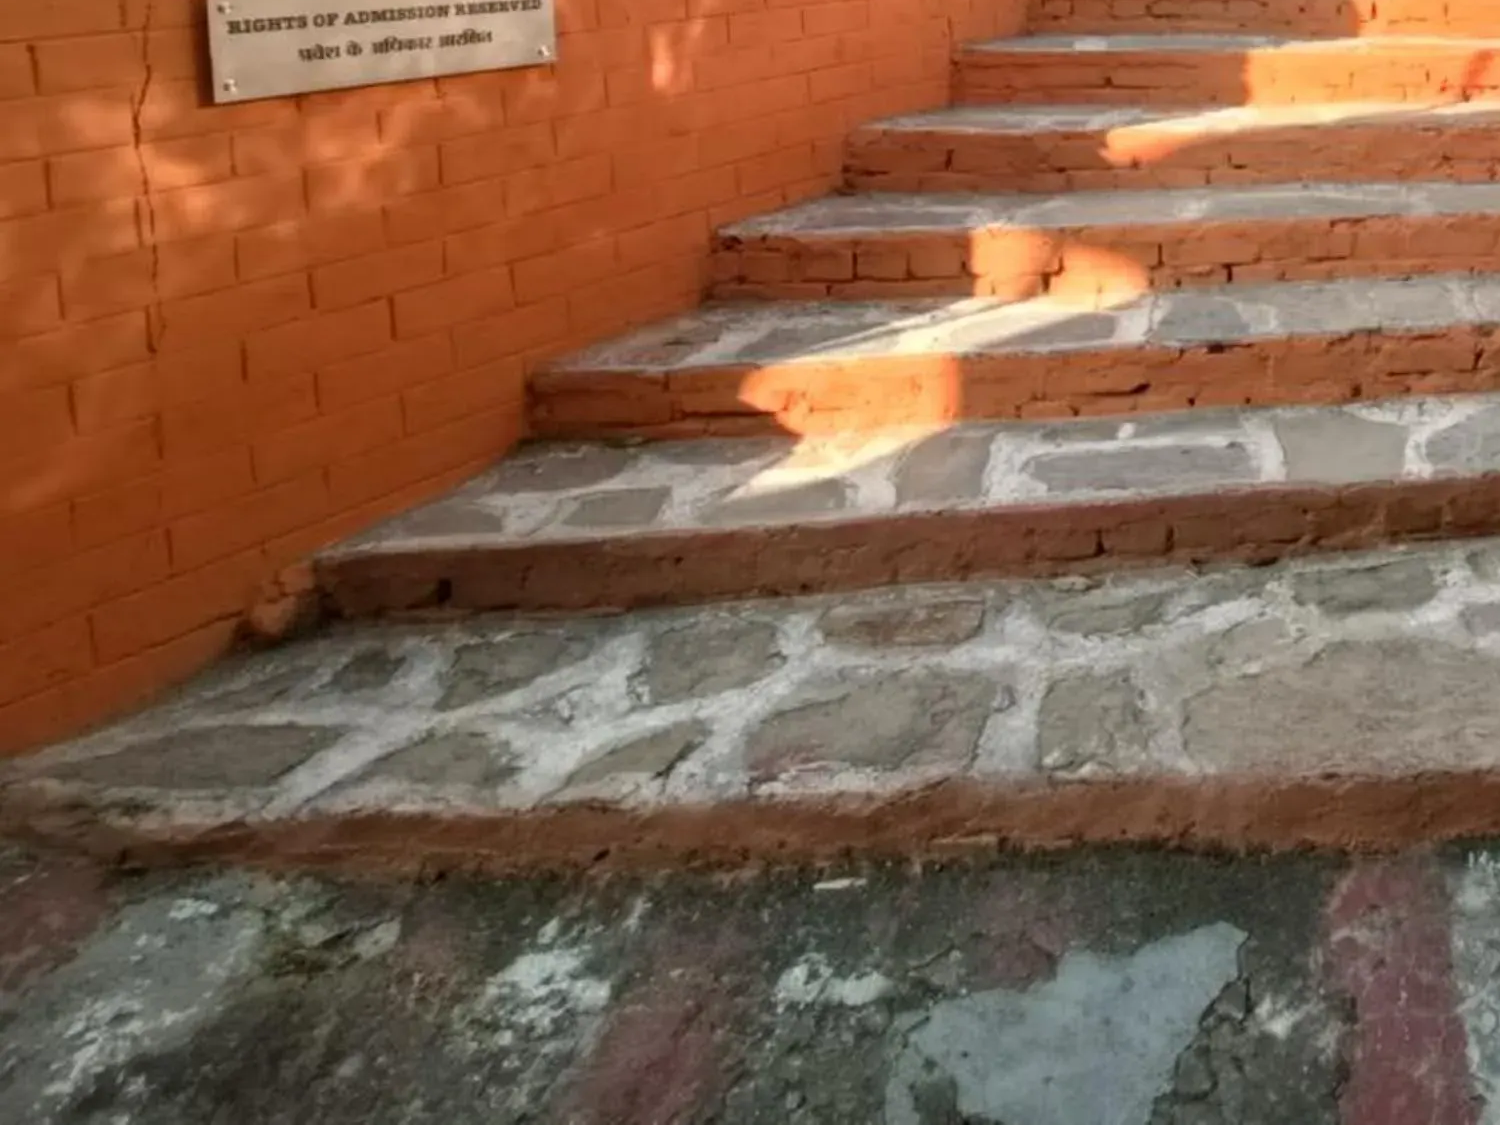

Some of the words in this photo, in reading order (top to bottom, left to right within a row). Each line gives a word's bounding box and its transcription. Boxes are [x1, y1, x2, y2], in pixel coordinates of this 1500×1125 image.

[226, 13, 308, 35] RIGHTS
[313, 12, 339, 28] OF
[344, 4, 450, 25] ADMISSION
[345, 39, 363, 57] के
